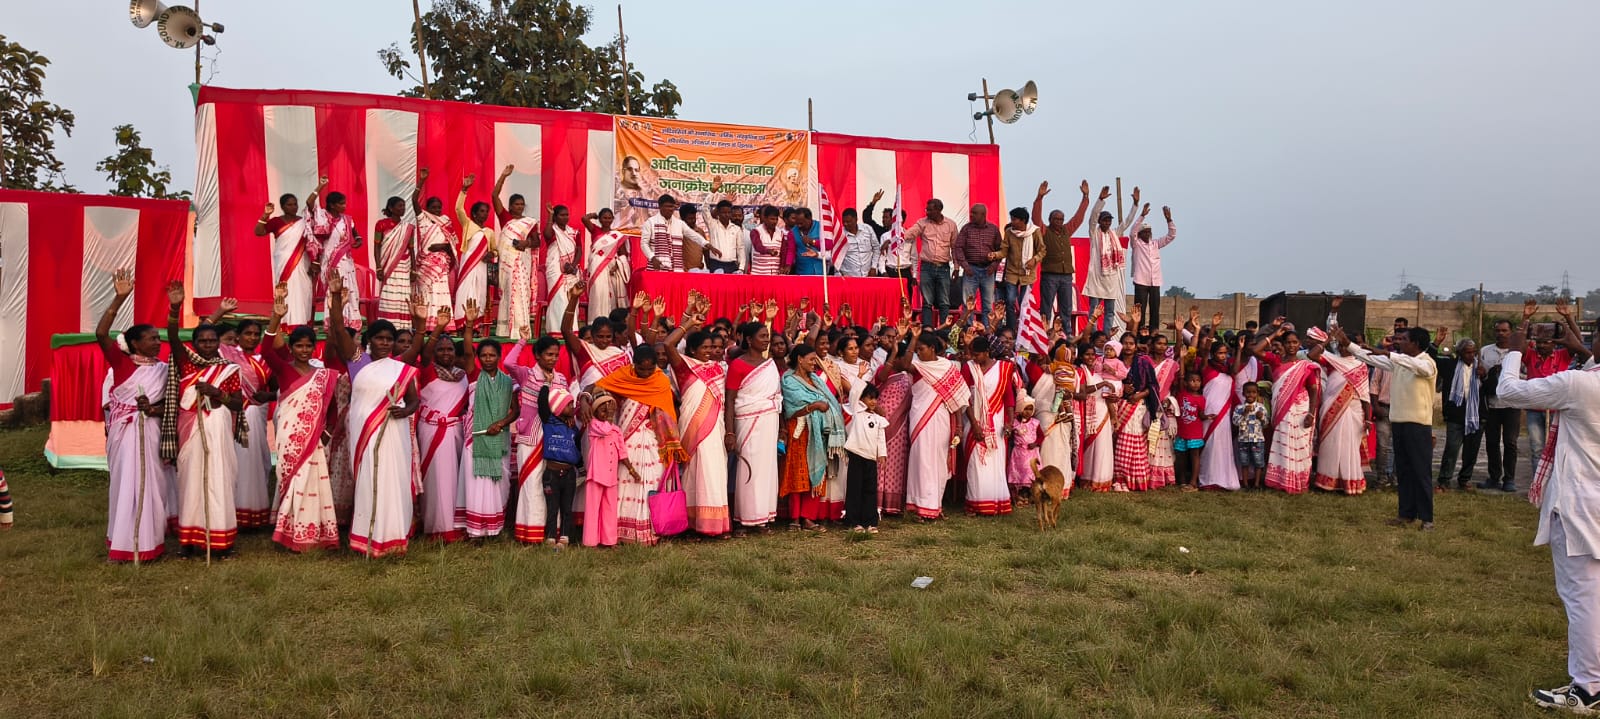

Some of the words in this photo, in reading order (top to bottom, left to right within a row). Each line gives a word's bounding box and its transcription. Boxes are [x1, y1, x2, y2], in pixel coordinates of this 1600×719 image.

[158, 12, 173, 43] SOUND
[651, 155, 707, 173] आदिवासी
[710, 162, 742, 175] सरना
[744, 164, 775, 177] बचाव
[658, 177, 713, 192] जनाक्रोश
